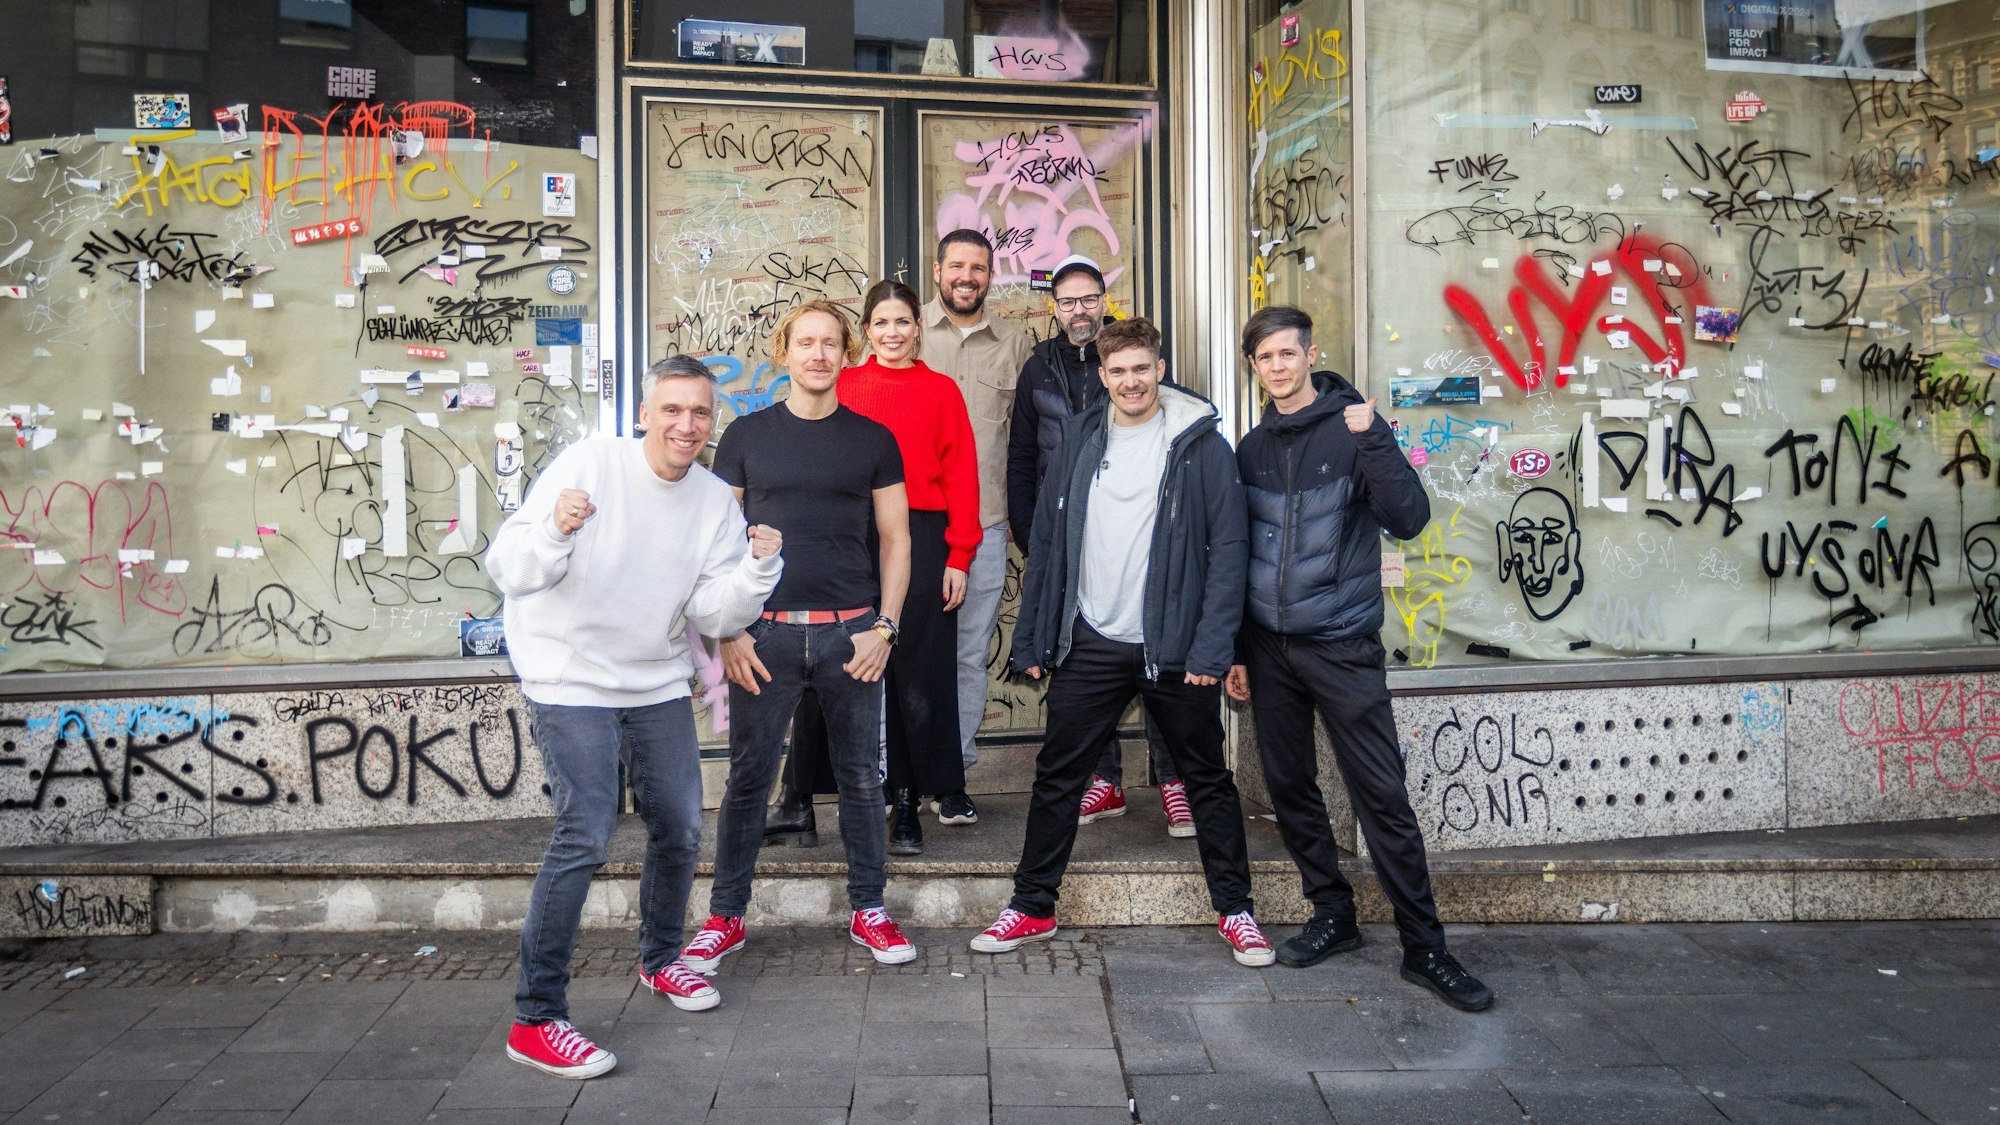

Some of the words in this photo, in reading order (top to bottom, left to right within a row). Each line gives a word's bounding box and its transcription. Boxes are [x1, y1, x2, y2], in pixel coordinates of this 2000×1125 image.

[1740, 4, 1779, 15] DIGITAL
[1728, 28, 1763, 38] READY
[1729, 38, 1751, 47] FOR
[1729, 48, 1768, 58] IMPACT
[328, 66, 376, 83] CARE
[551, 269, 572, 279] HARD
[763, 252, 862, 295] SUKA
[551, 282, 574, 292] VIBES
[527, 305, 589, 318] ZEITRAUM
[1514, 453, 1546, 474] TSP
